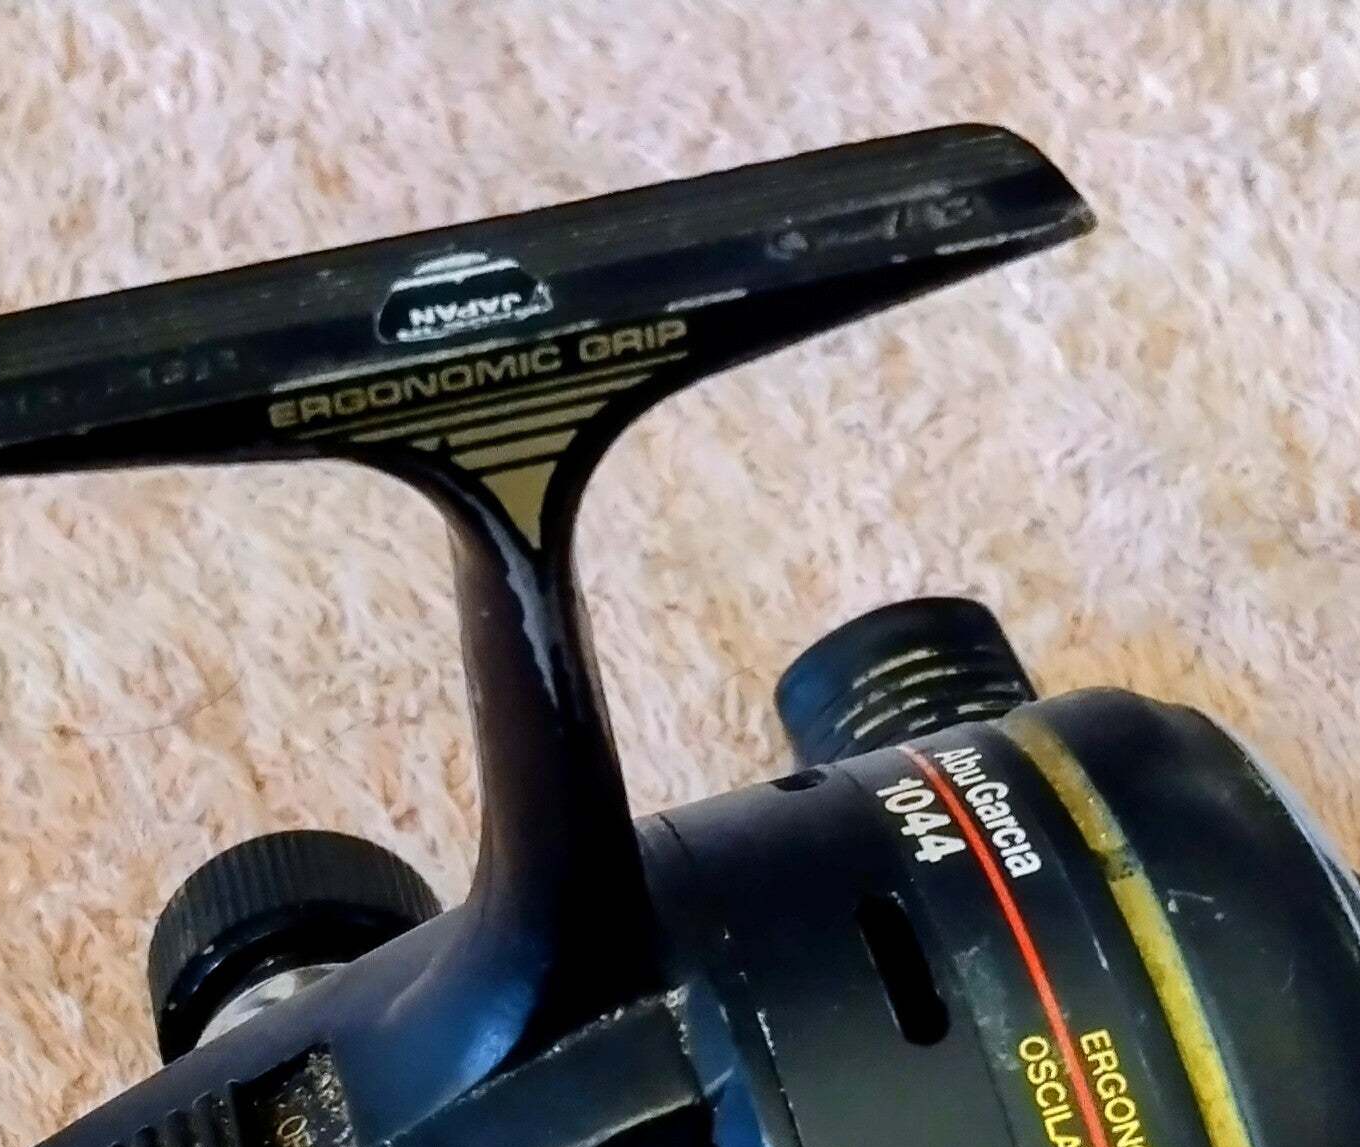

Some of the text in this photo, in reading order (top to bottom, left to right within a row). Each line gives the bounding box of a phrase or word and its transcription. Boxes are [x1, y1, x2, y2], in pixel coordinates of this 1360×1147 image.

[408, 293, 522, 327] JAPAN
[269, 318, 687, 429] ERGONOMIC GRIP
[876, 777, 966, 862] 1044
[934, 747, 1042, 878] Abu Garcia
